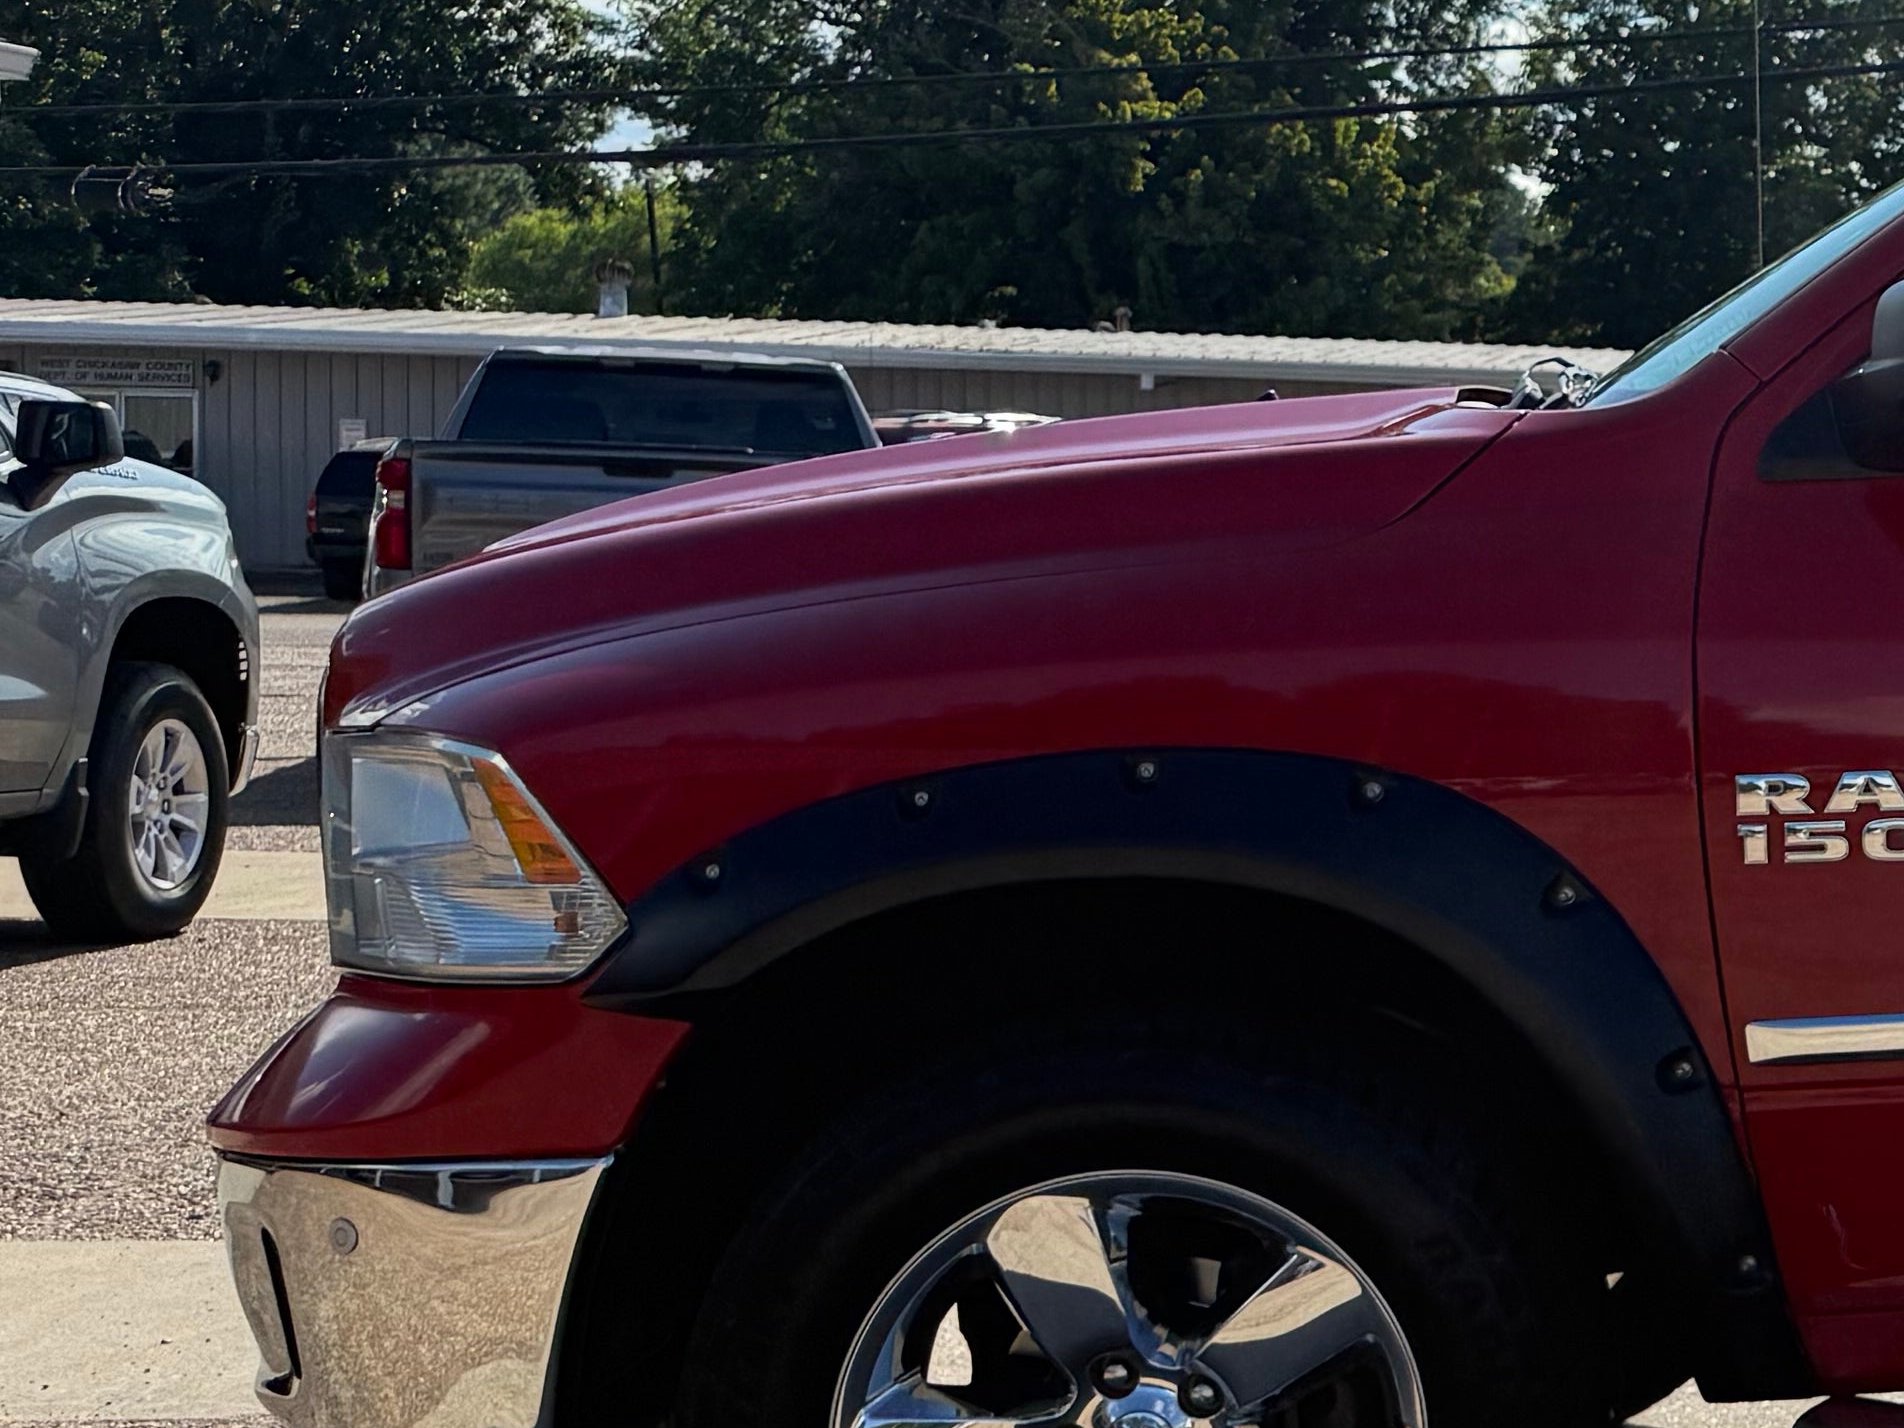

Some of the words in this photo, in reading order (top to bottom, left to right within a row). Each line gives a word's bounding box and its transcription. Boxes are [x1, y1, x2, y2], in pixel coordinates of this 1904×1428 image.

[39, 358, 70, 369] WEST
[145, 359, 191, 371] COUNTY
[75, 371, 89, 381] OF
[93, 371, 133, 382] HUMAN
[137, 372, 191, 383] SERVICES
